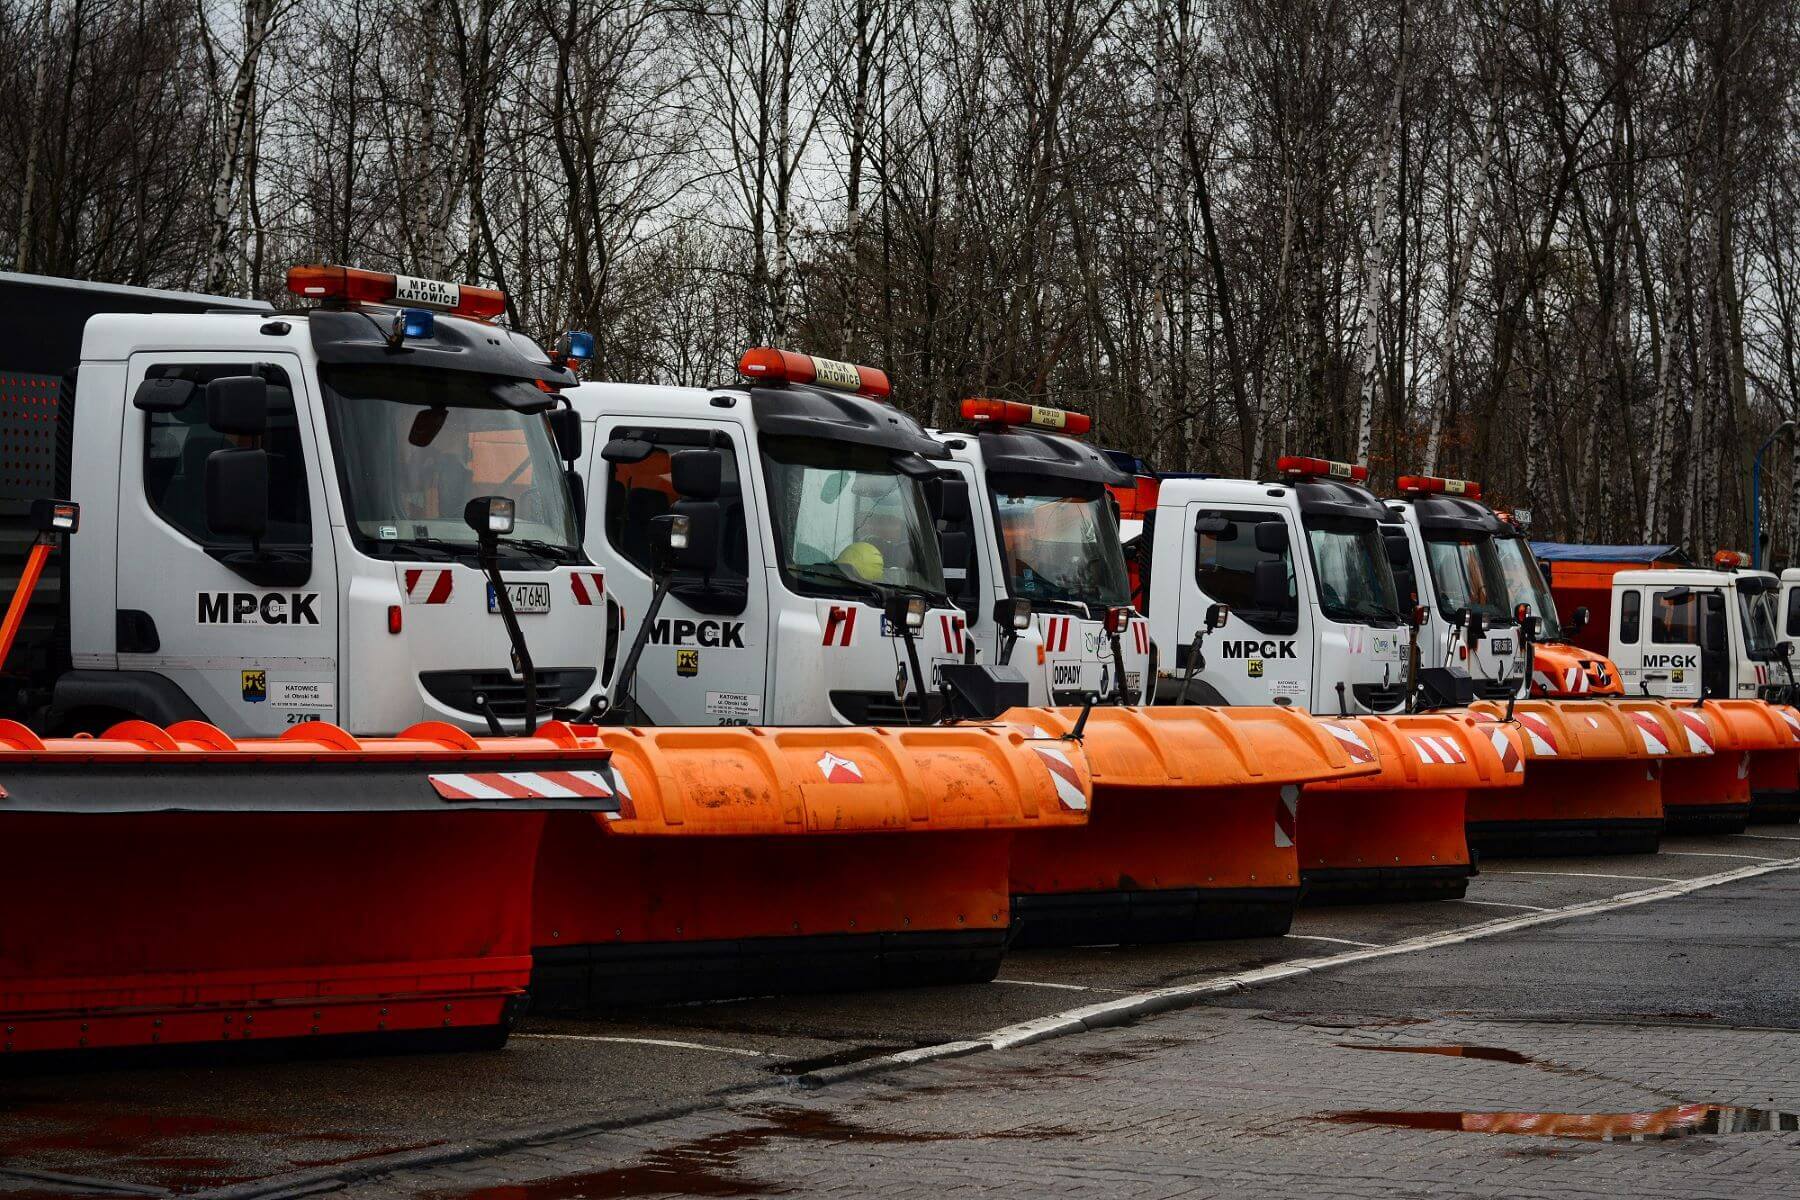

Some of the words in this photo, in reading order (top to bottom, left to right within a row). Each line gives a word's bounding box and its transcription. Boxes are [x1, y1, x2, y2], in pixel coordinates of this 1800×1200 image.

[409, 280, 446, 294] MPGK
[398, 289, 458, 305] KATOWICE
[817, 369, 860, 385] KATOWICE
[198, 592, 320, 625] MPGK
[645, 619, 745, 648] MPGK
[1222, 640, 1297, 659] MPGK
[1643, 655, 1697, 668] MPGK
[1054, 665, 1081, 685] ODPADY
